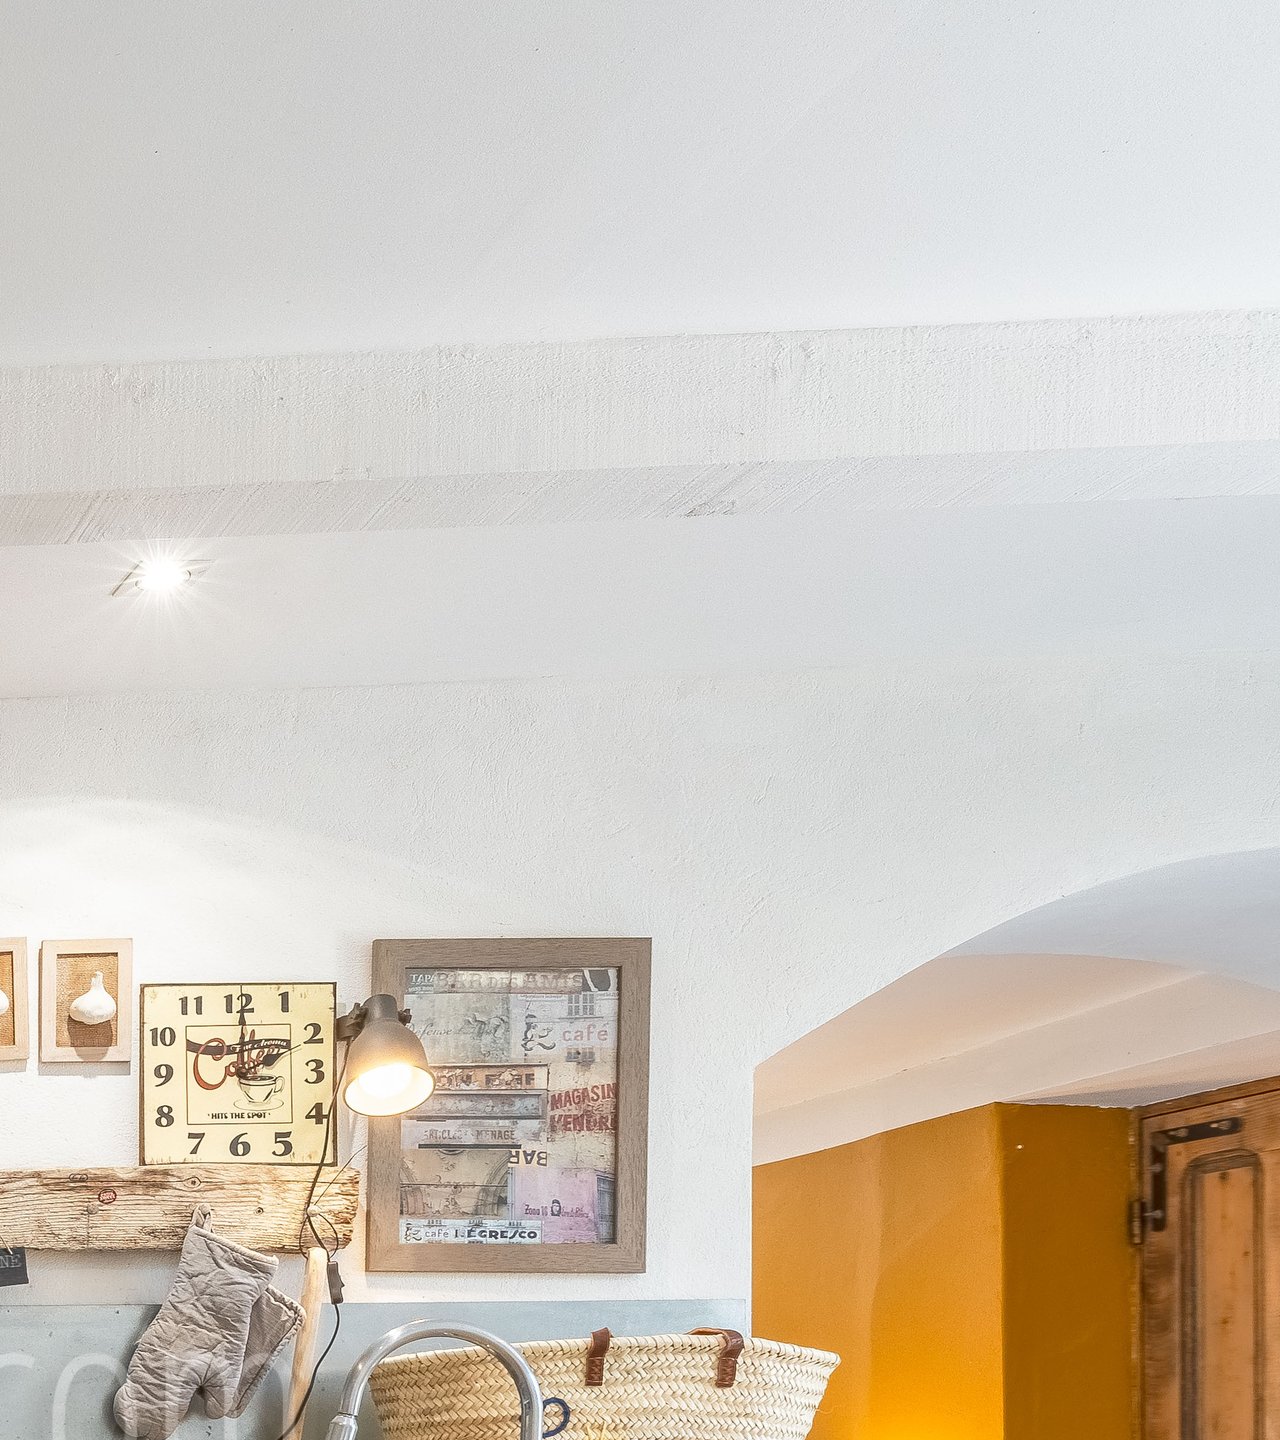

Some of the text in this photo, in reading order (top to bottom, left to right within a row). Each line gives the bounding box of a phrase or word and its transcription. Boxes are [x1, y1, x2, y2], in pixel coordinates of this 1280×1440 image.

[179, 991, 290, 1015] 11 12 1
[149, 1027, 176, 1047] 10
[303, 1022, 324, 1044] 2
[154, 1064, 174, 1087] 9
[304, 1059, 325, 1084] 3
[550, 1083, 616, 1111] MAGASIN
[155, 1104, 175, 1127] 8
[305, 1102, 328, 1125] 4
[187, 1132, 205, 1155] 7
[229, 1132, 251, 1156] 6
[272, 1131, 293, 1156] 5
